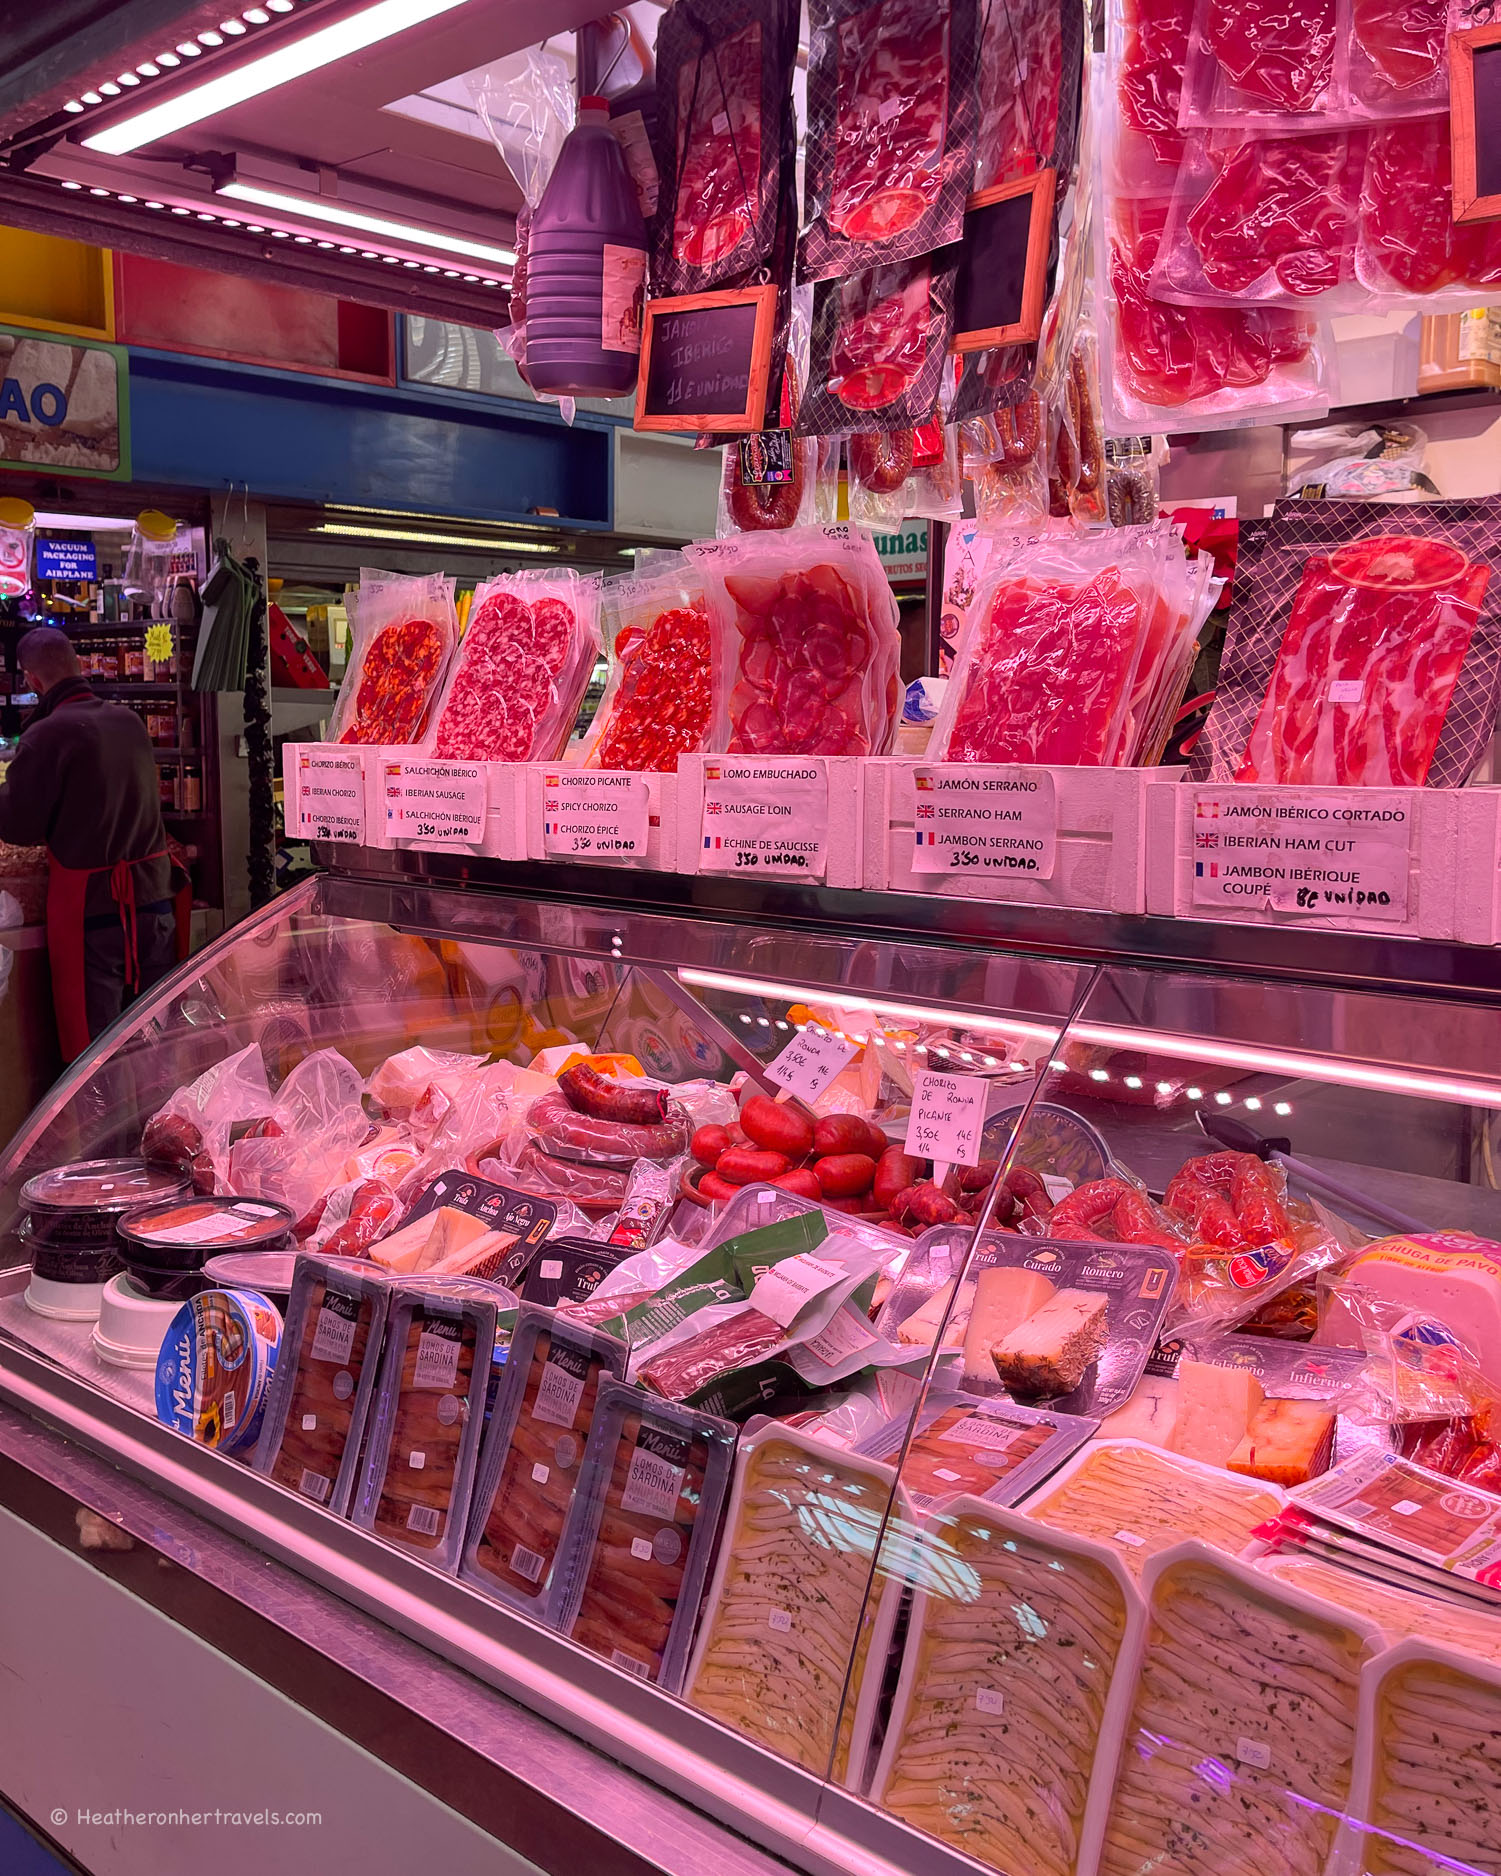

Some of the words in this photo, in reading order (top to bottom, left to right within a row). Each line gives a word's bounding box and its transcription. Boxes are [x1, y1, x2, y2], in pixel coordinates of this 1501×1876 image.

[49, 542, 88, 552] VACUUM
[43, 551, 95, 561] PACKAGING
[60, 561, 78, 570] FOR
[46, 569, 94, 579] AIRPLANE
[311, 760, 334, 769] CHORIZO
[335, 760, 355, 770] IBÉRICO
[404, 766, 450, 777] SALCHICHÓN
[451, 768, 477, 778] IBÉRICO
[723, 769, 751, 779] LOMO
[753, 770, 817, 779] EMBUCHADO
[561, 777, 595, 786] CHORIZO
[597, 777, 631, 786] PICANTE
[937, 778, 980, 790] JAMÓN
[982, 780, 1037, 792] SERRANO
[312, 788, 332, 796] IBERIAN
[332, 789, 356, 797] CHORIZO
[405, 789, 435, 798] IBERIAN
[436, 790, 465, 800] SAUSAGE
[561, 802, 581, 811] SPICY
[582, 803, 618, 812] CHORIZO
[725, 804, 765, 814] SAUSAGE
[767, 806, 792, 815] LOIN
[1223, 805, 1272, 818] JAMÓN
[1275, 805, 1329, 820] IBÉRICO
[1332, 809, 1405, 822] CORTADO
[312, 814, 335, 824] CHORIZO
[336, 815, 360, 826] IBÉRIQUE
[405, 810, 451, 821] SALCHICHÓN
[452, 814, 481, 824] IBÉRIQUE
[938, 808, 991, 819] SERRANO
[994, 810, 1022, 821] HAM
[560, 825, 595, 834] CHORIZO
[597, 824, 619, 835] ÉPICÉ
[596, 839, 635, 850] UNIDAD
[724, 837, 757, 849] ÉCHINE
[759, 840, 772, 850] DE
[774, 841, 819, 852] SAUCISSE
[938, 835, 987, 847] JAMBON
[989, 837, 1044, 850] SERRANO
[1223, 835, 1282, 848] IBERIAN
[1285, 838, 1320, 851] HAM
[1325, 840, 1356, 852] CUT
[1222, 865, 1286, 879] JAMBON
[1289, 867, 1360, 883] IBÉRIQUE
[1222, 882, 1272, 896] COUPÉ
[1324, 887, 1391, 906] UNIDAD
[922, 1076, 957, 1091] CHORIZO
[921, 1089, 933, 1101] DE
[918, 1108, 952, 1122] PICANTE
[916, 1126, 940, 1141] 3,50€
[918, 1143, 930, 1153] 1/4
[975, 1252, 998, 1264] rufa
[1023, 1259, 1062, 1273] Curado
[1081, 1265, 1124, 1279] Romero
[1434, 1256, 1454, 1265] DE
[1456, 1258, 1499, 1276] PAVO
[577, 1277, 600, 1290] Truf
[325, 1295, 354, 1316] Menú
[195, 1297, 206, 1337] ANCHOA
[319, 1325, 349, 1344] SARDINA
[426, 1319, 457, 1337] Menú
[199, 1339, 207, 1349] de
[422, 1340, 444, 1353] LOMOS
[446, 1345, 455, 1355] DE
[419, 1350, 454, 1366] SARDINA
[551, 1348, 582, 1374] Menú
[172, 1334, 194, 1419] Menú
[545, 1371, 568, 1388] LOMOS
[569, 1381, 579, 1392] DE
[1289, 1371, 1344, 1389] Infierno
[542, 1380, 575, 1405] SARDINA
[957, 1423, 1010, 1441] SARDINA
[641, 1432, 681, 1460] Menú
[634, 1455, 664, 1476] LOMOS
[631, 1466, 675, 1496] SARDINA
